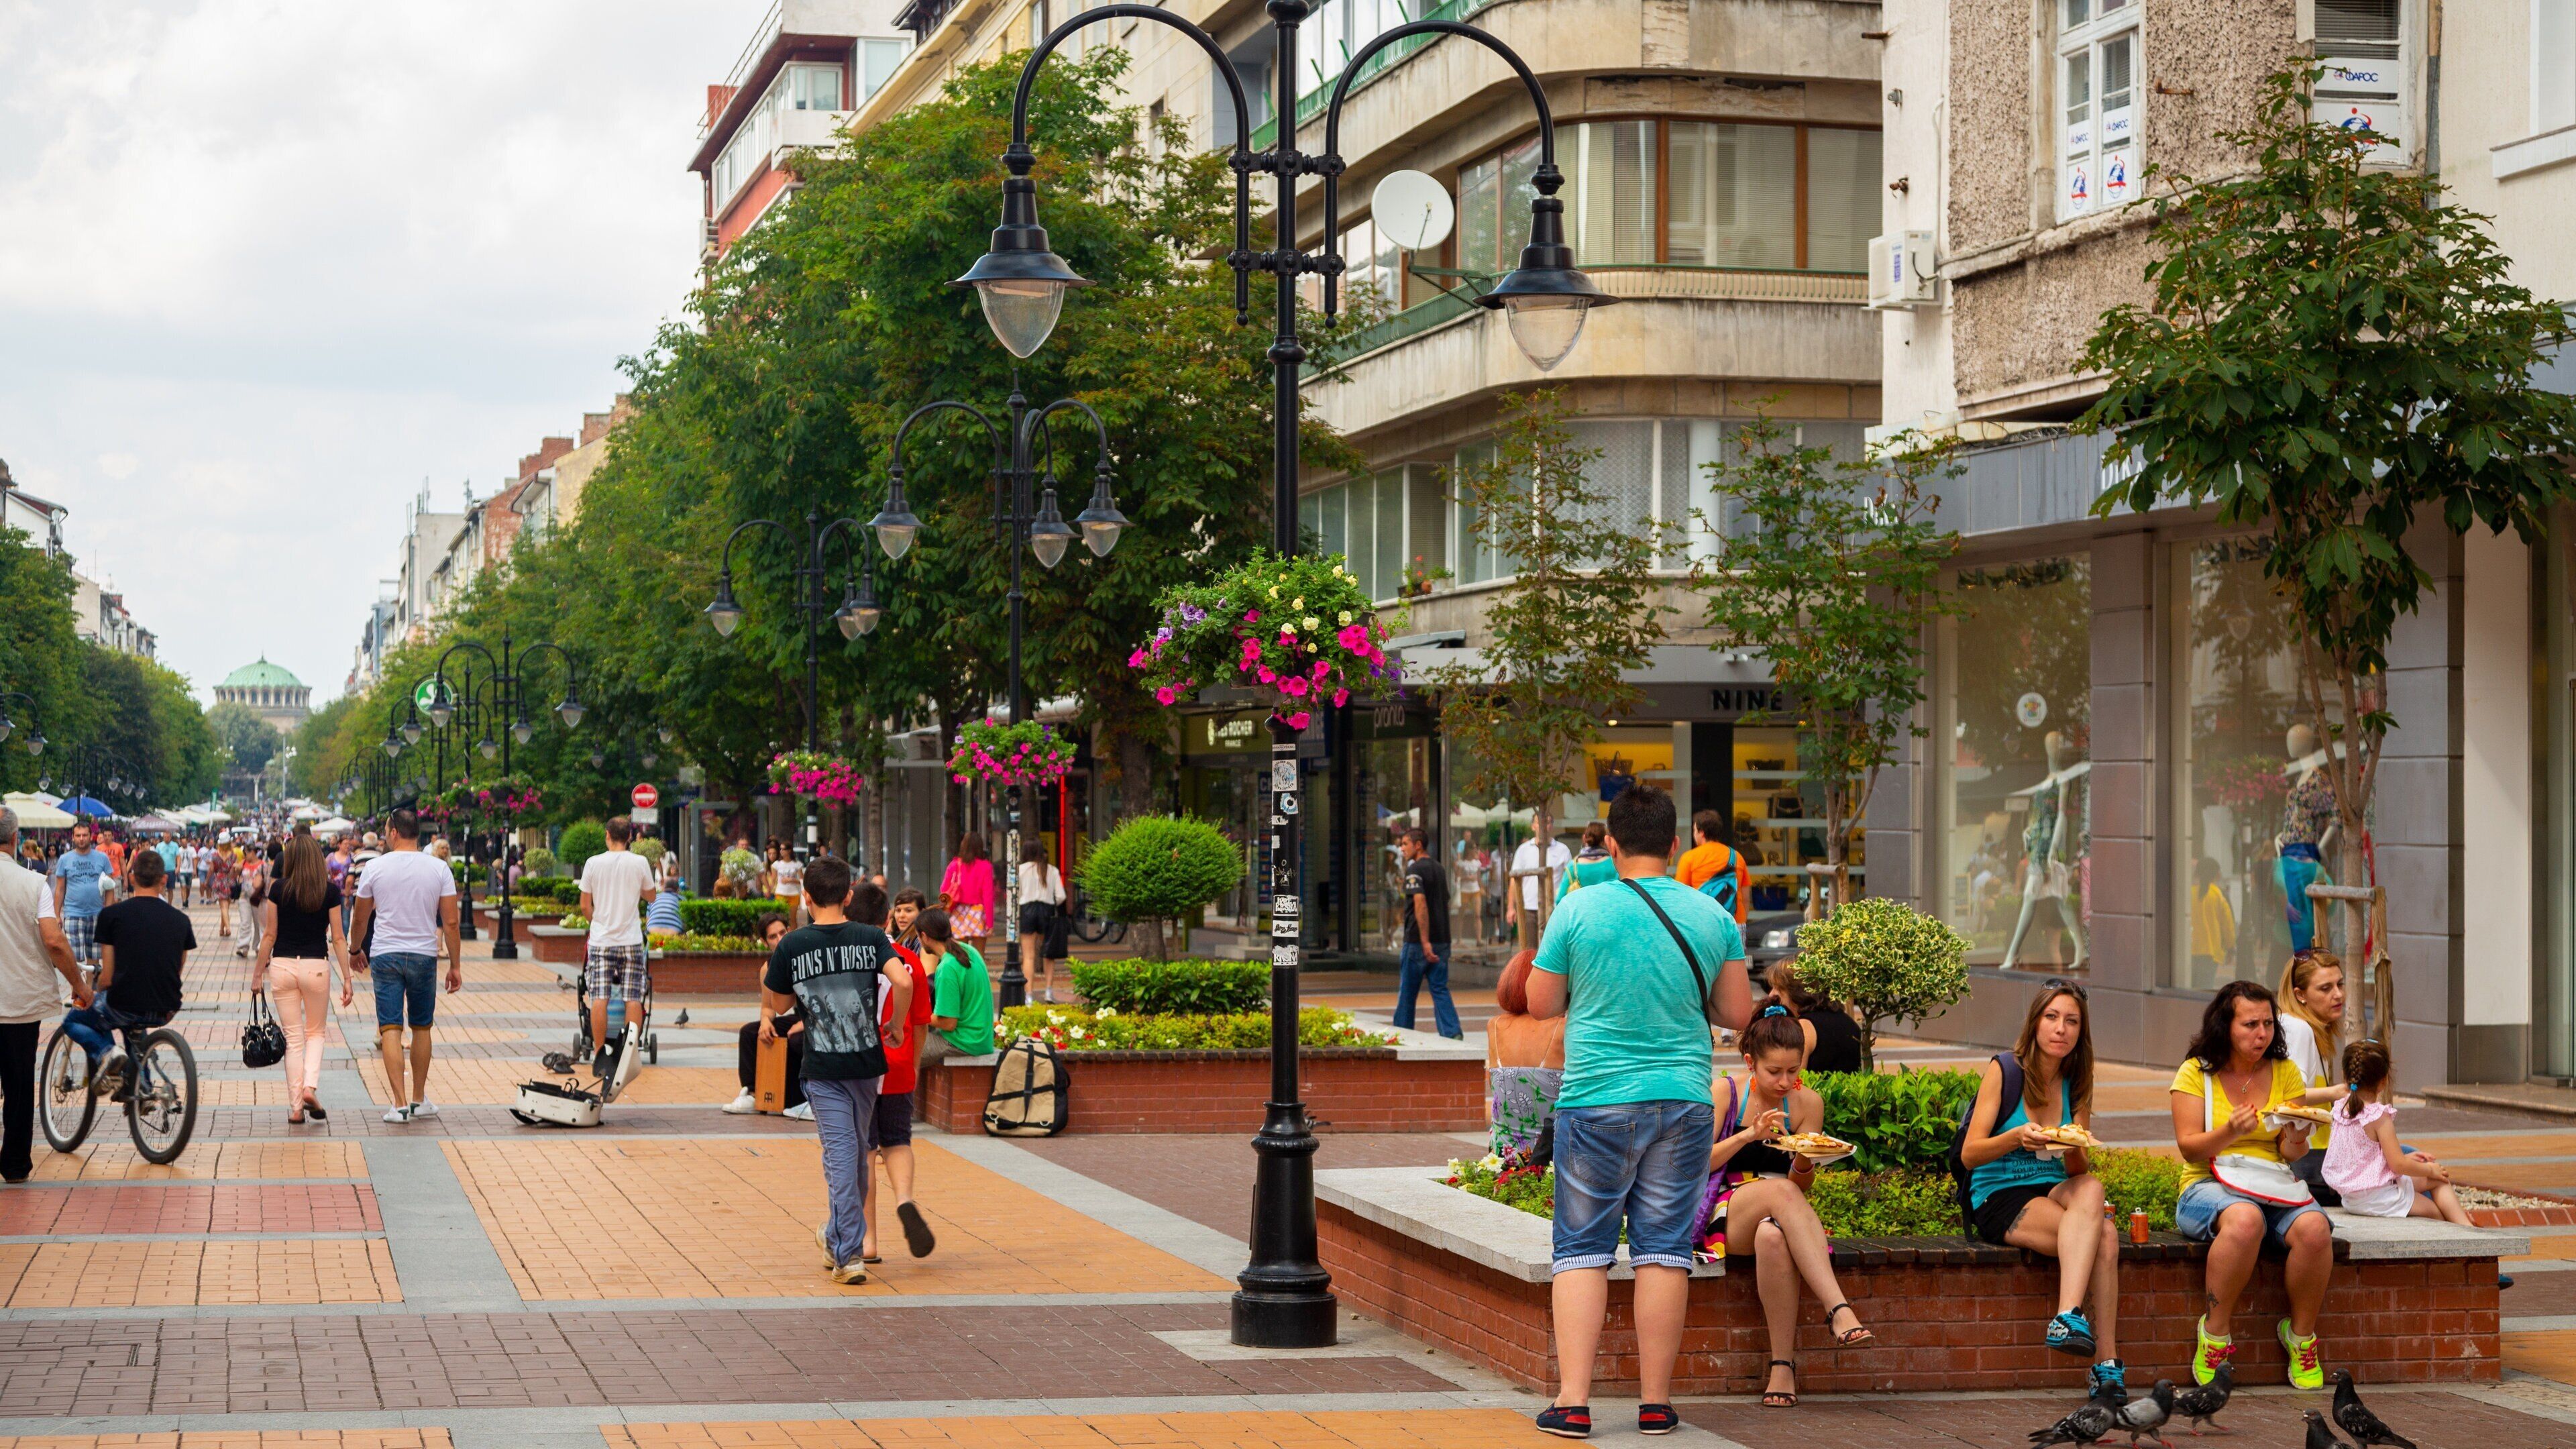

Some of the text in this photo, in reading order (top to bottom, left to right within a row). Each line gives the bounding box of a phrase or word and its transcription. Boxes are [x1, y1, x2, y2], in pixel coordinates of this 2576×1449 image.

[2345, 68, 2378, 82] ФАРОС
[1713, 690, 1782, 710] NINE
[1228, 720, 1252, 736] ROCHER
[792, 949, 822, 981] GUNS
[841, 945, 876, 971] ROSES
